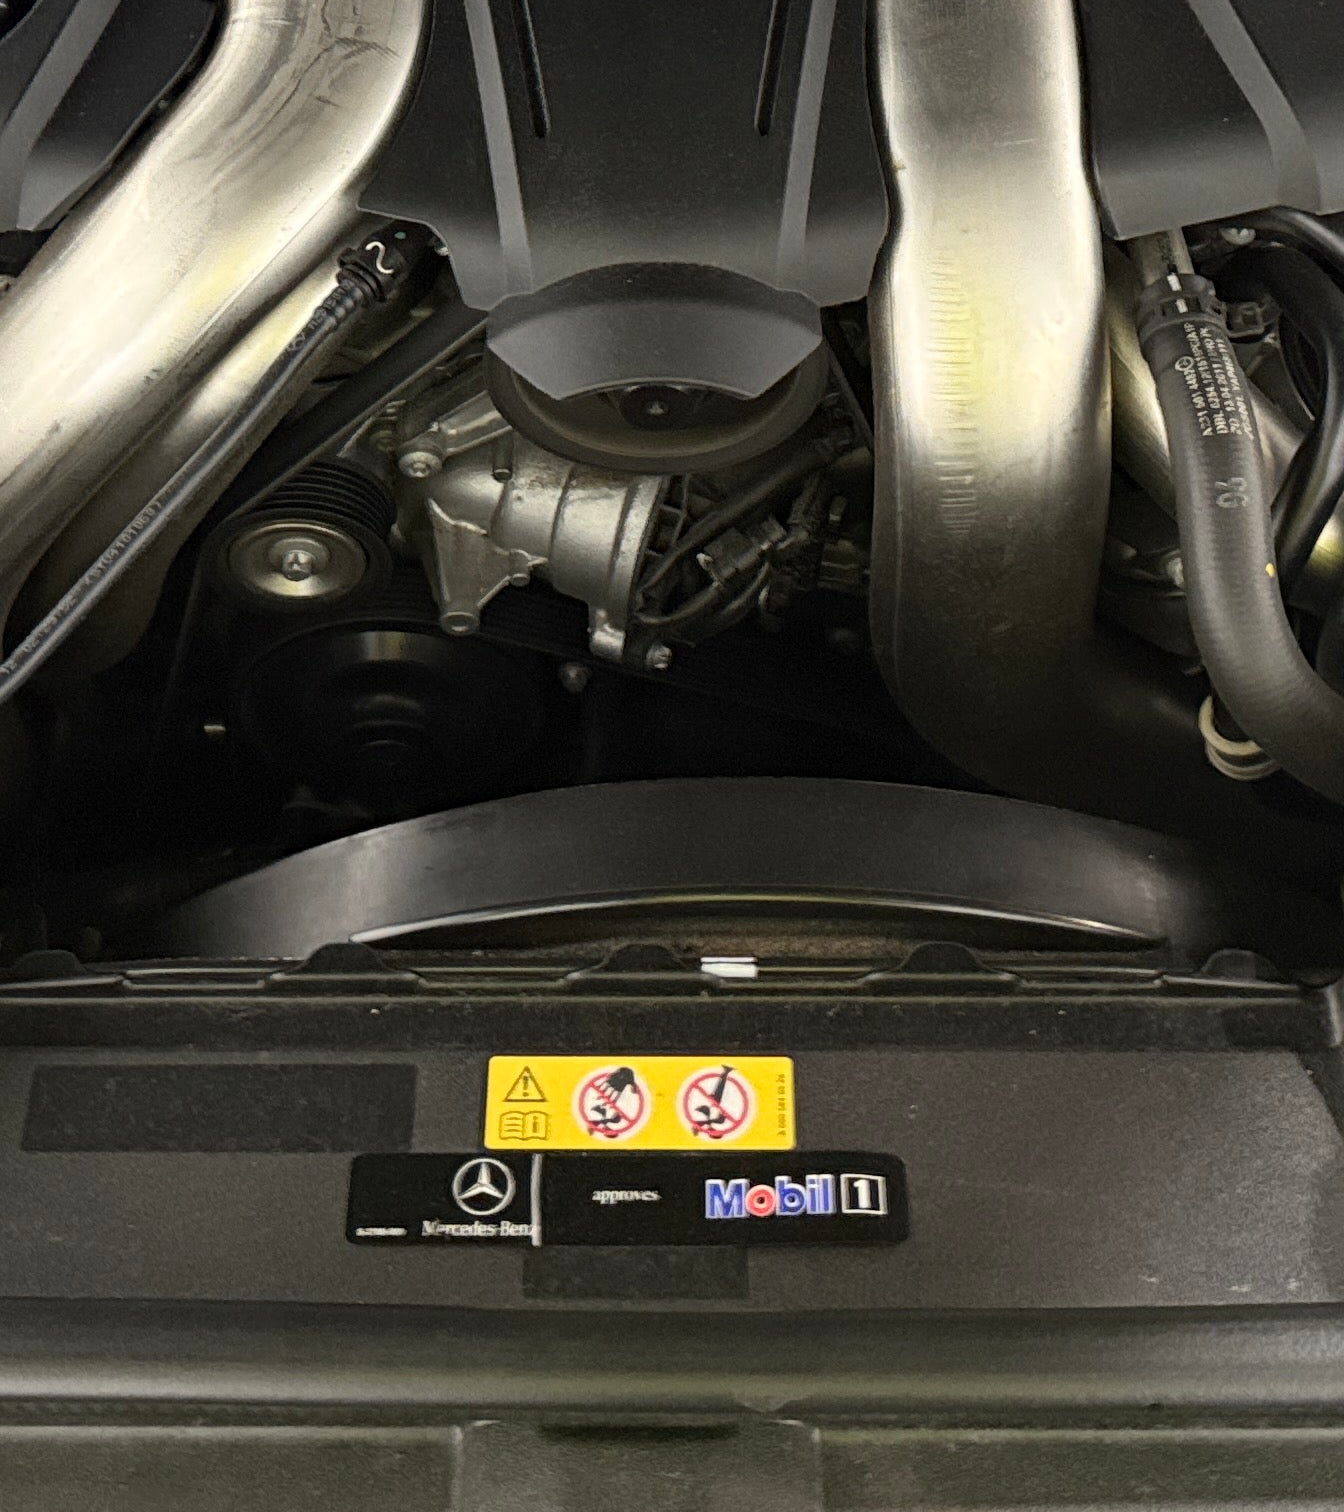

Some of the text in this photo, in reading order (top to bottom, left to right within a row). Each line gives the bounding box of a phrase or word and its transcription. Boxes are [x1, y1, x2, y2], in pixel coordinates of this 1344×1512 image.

[592, 1189, 659, 1205] approves
[705, 1173, 836, 1219] Mobil
[421, 1220, 540, 1237] Mercedes-Benz
